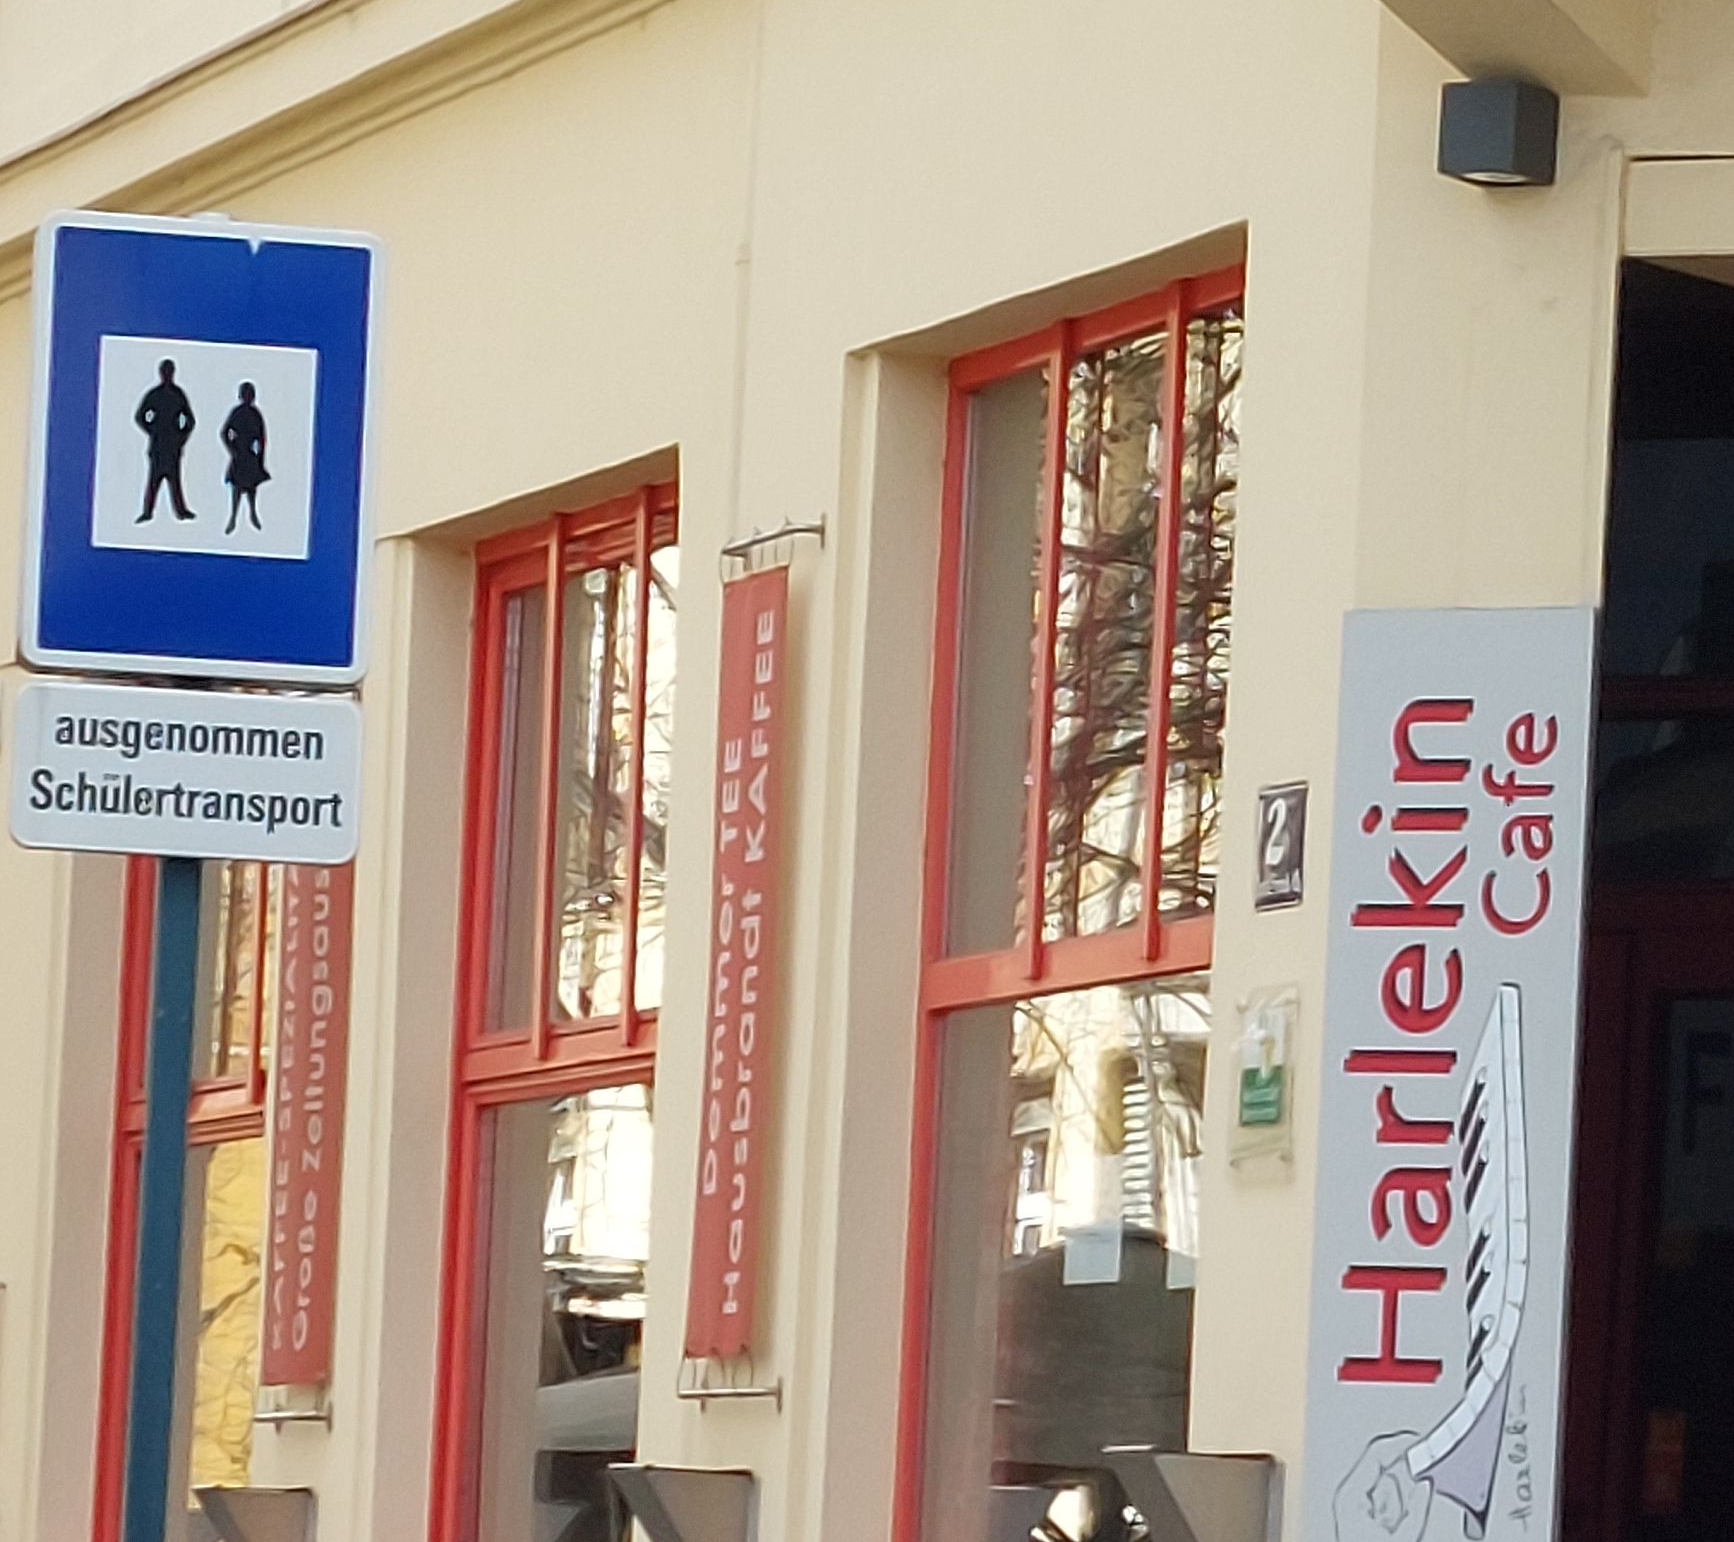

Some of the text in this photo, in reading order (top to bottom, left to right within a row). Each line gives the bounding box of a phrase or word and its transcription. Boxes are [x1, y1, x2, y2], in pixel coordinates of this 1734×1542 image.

[30, 769, 343, 834] Schülertransport
[55, 716, 324, 761] ausgenommen
[719, 738, 743, 853] TEE
[1482, 711, 1558, 935] Cafe
[720, 610, 776, 1316] Hausbrandt KAFFEE
[1336, 696, 1475, 1383] Harlekin
[291, 1189, 318, 1352] Große
